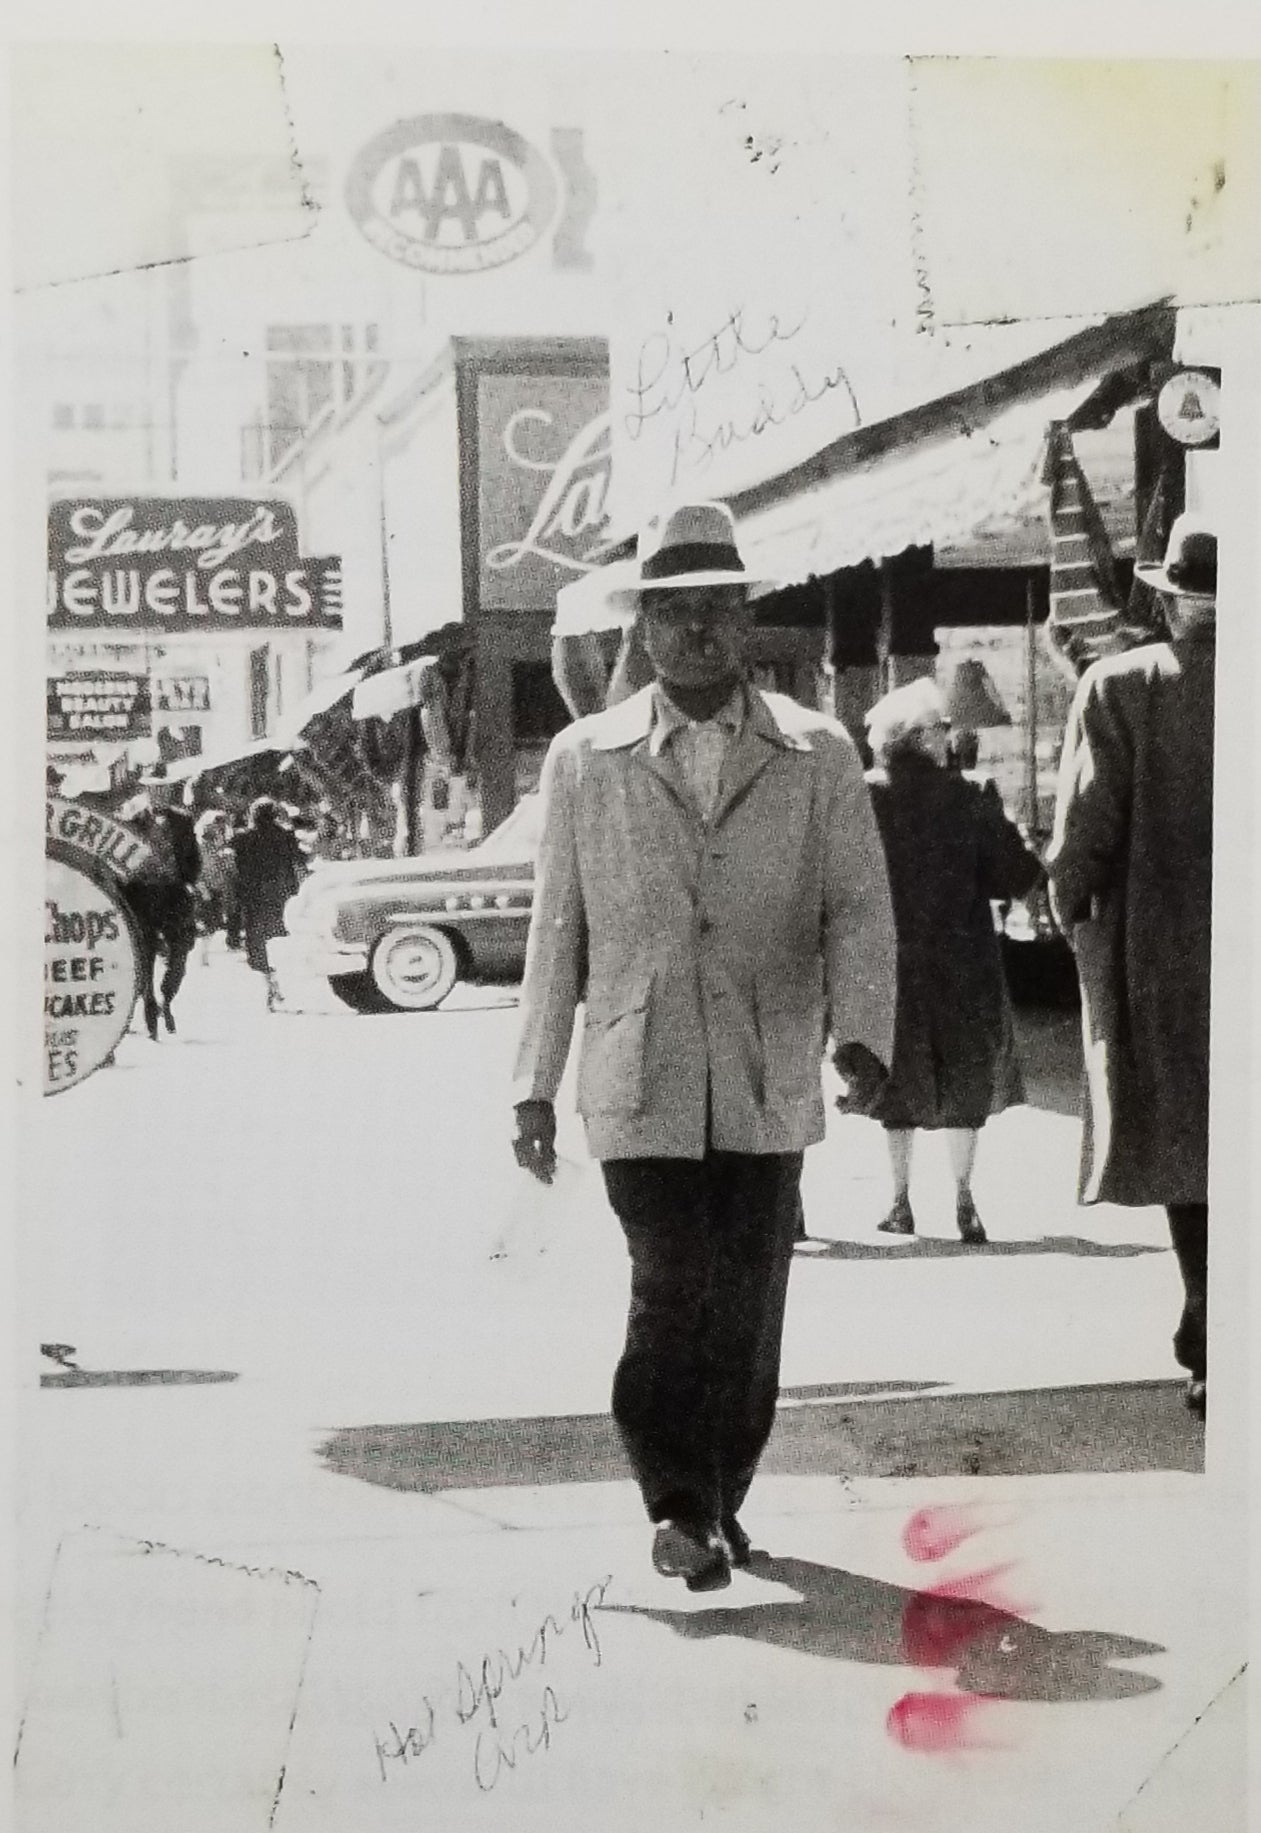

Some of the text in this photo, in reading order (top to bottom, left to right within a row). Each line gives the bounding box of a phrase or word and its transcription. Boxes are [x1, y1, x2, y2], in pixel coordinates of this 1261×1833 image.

[389, 143, 512, 240] AAA
[670, 366, 862, 487] Buddy
[44, 956, 104, 982] EEF
[44, 991, 116, 1017] CAKES
